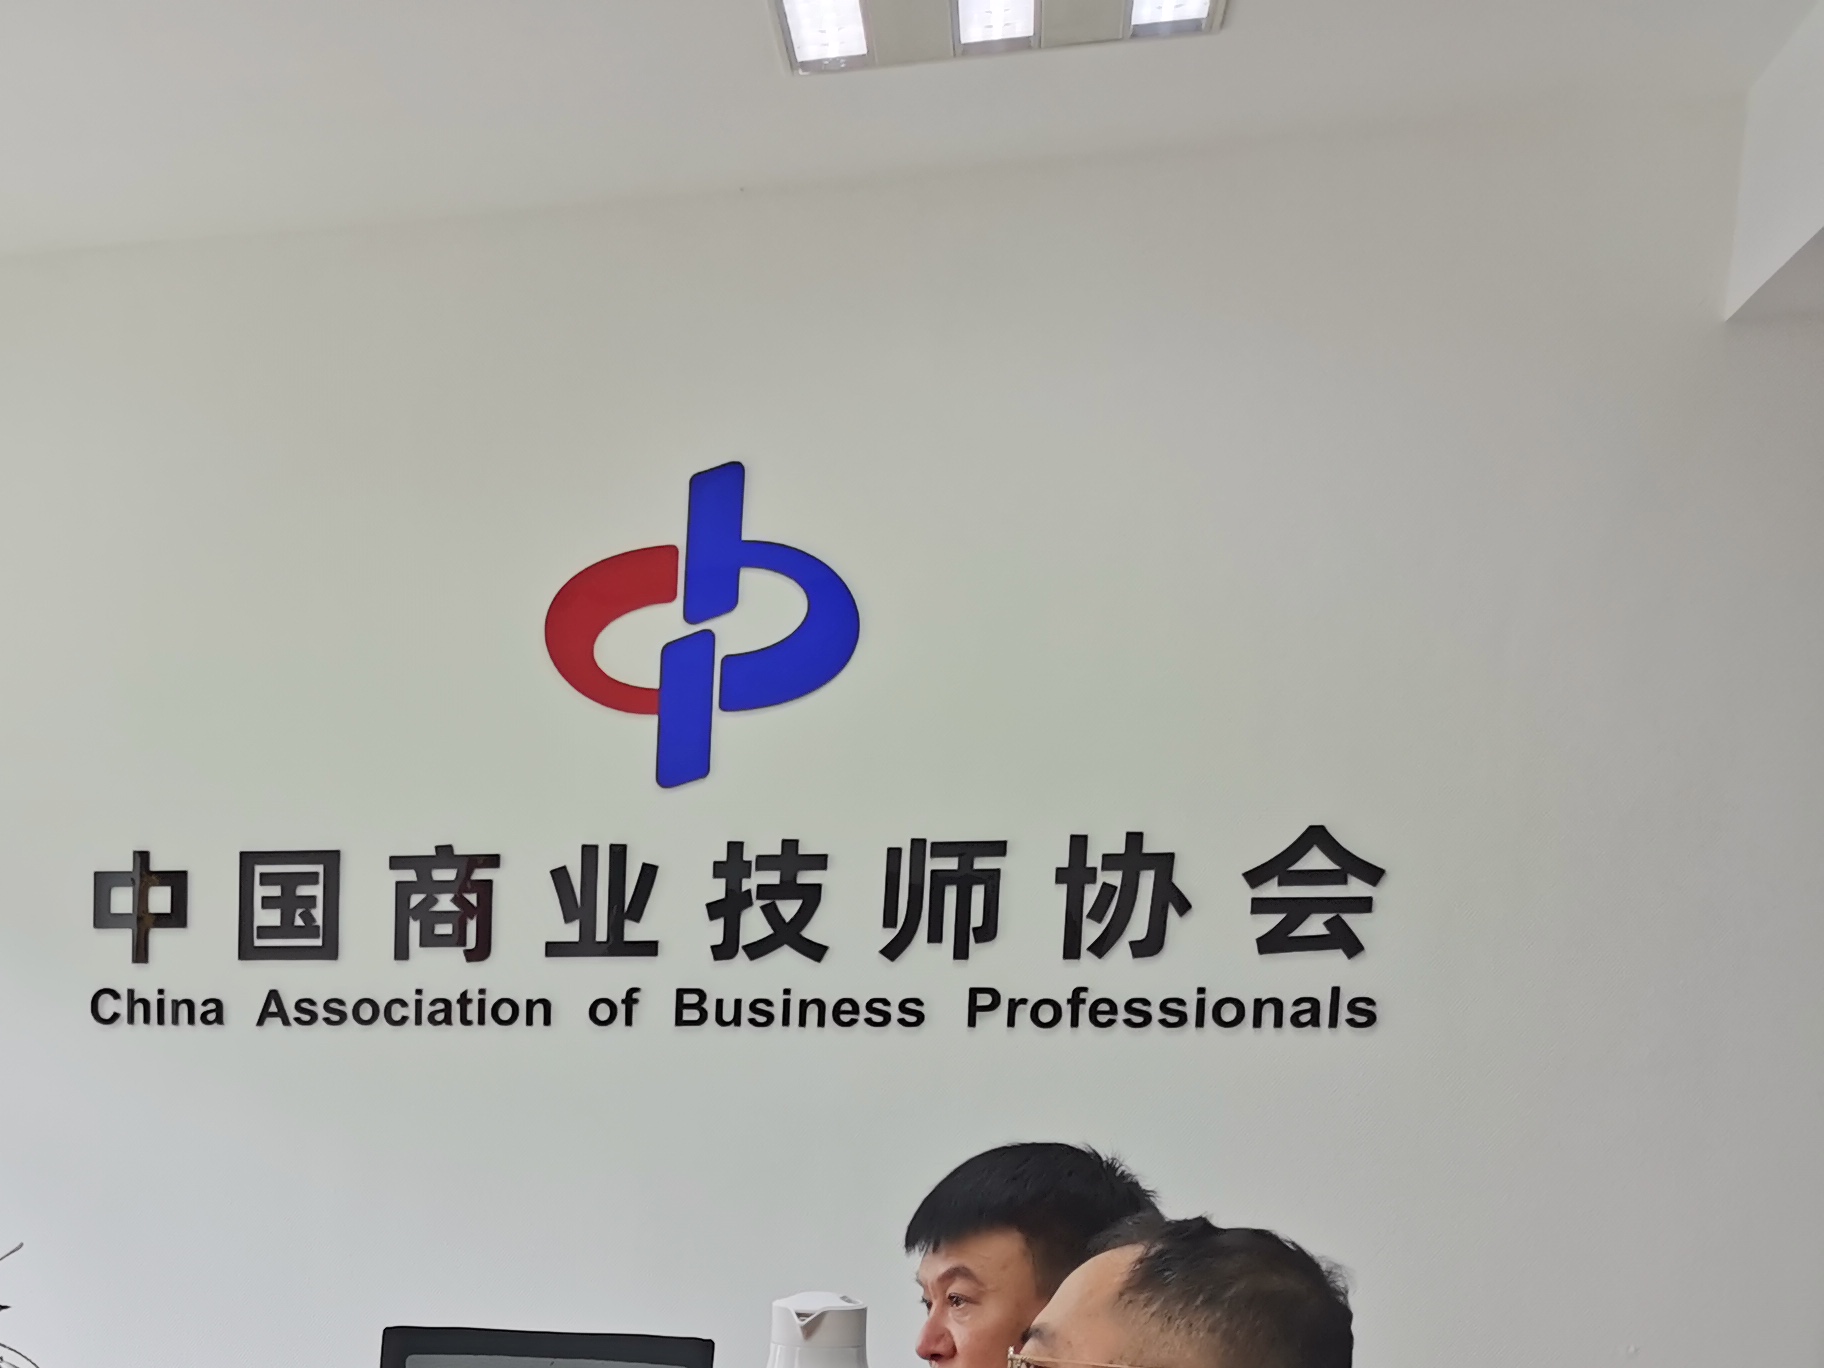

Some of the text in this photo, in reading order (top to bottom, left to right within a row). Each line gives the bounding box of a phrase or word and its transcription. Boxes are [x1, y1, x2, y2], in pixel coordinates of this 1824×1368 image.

[92, 823, 1387, 965] 中国商业技师协会
[90, 984, 1378, 1029] China Association of Business Professionals
